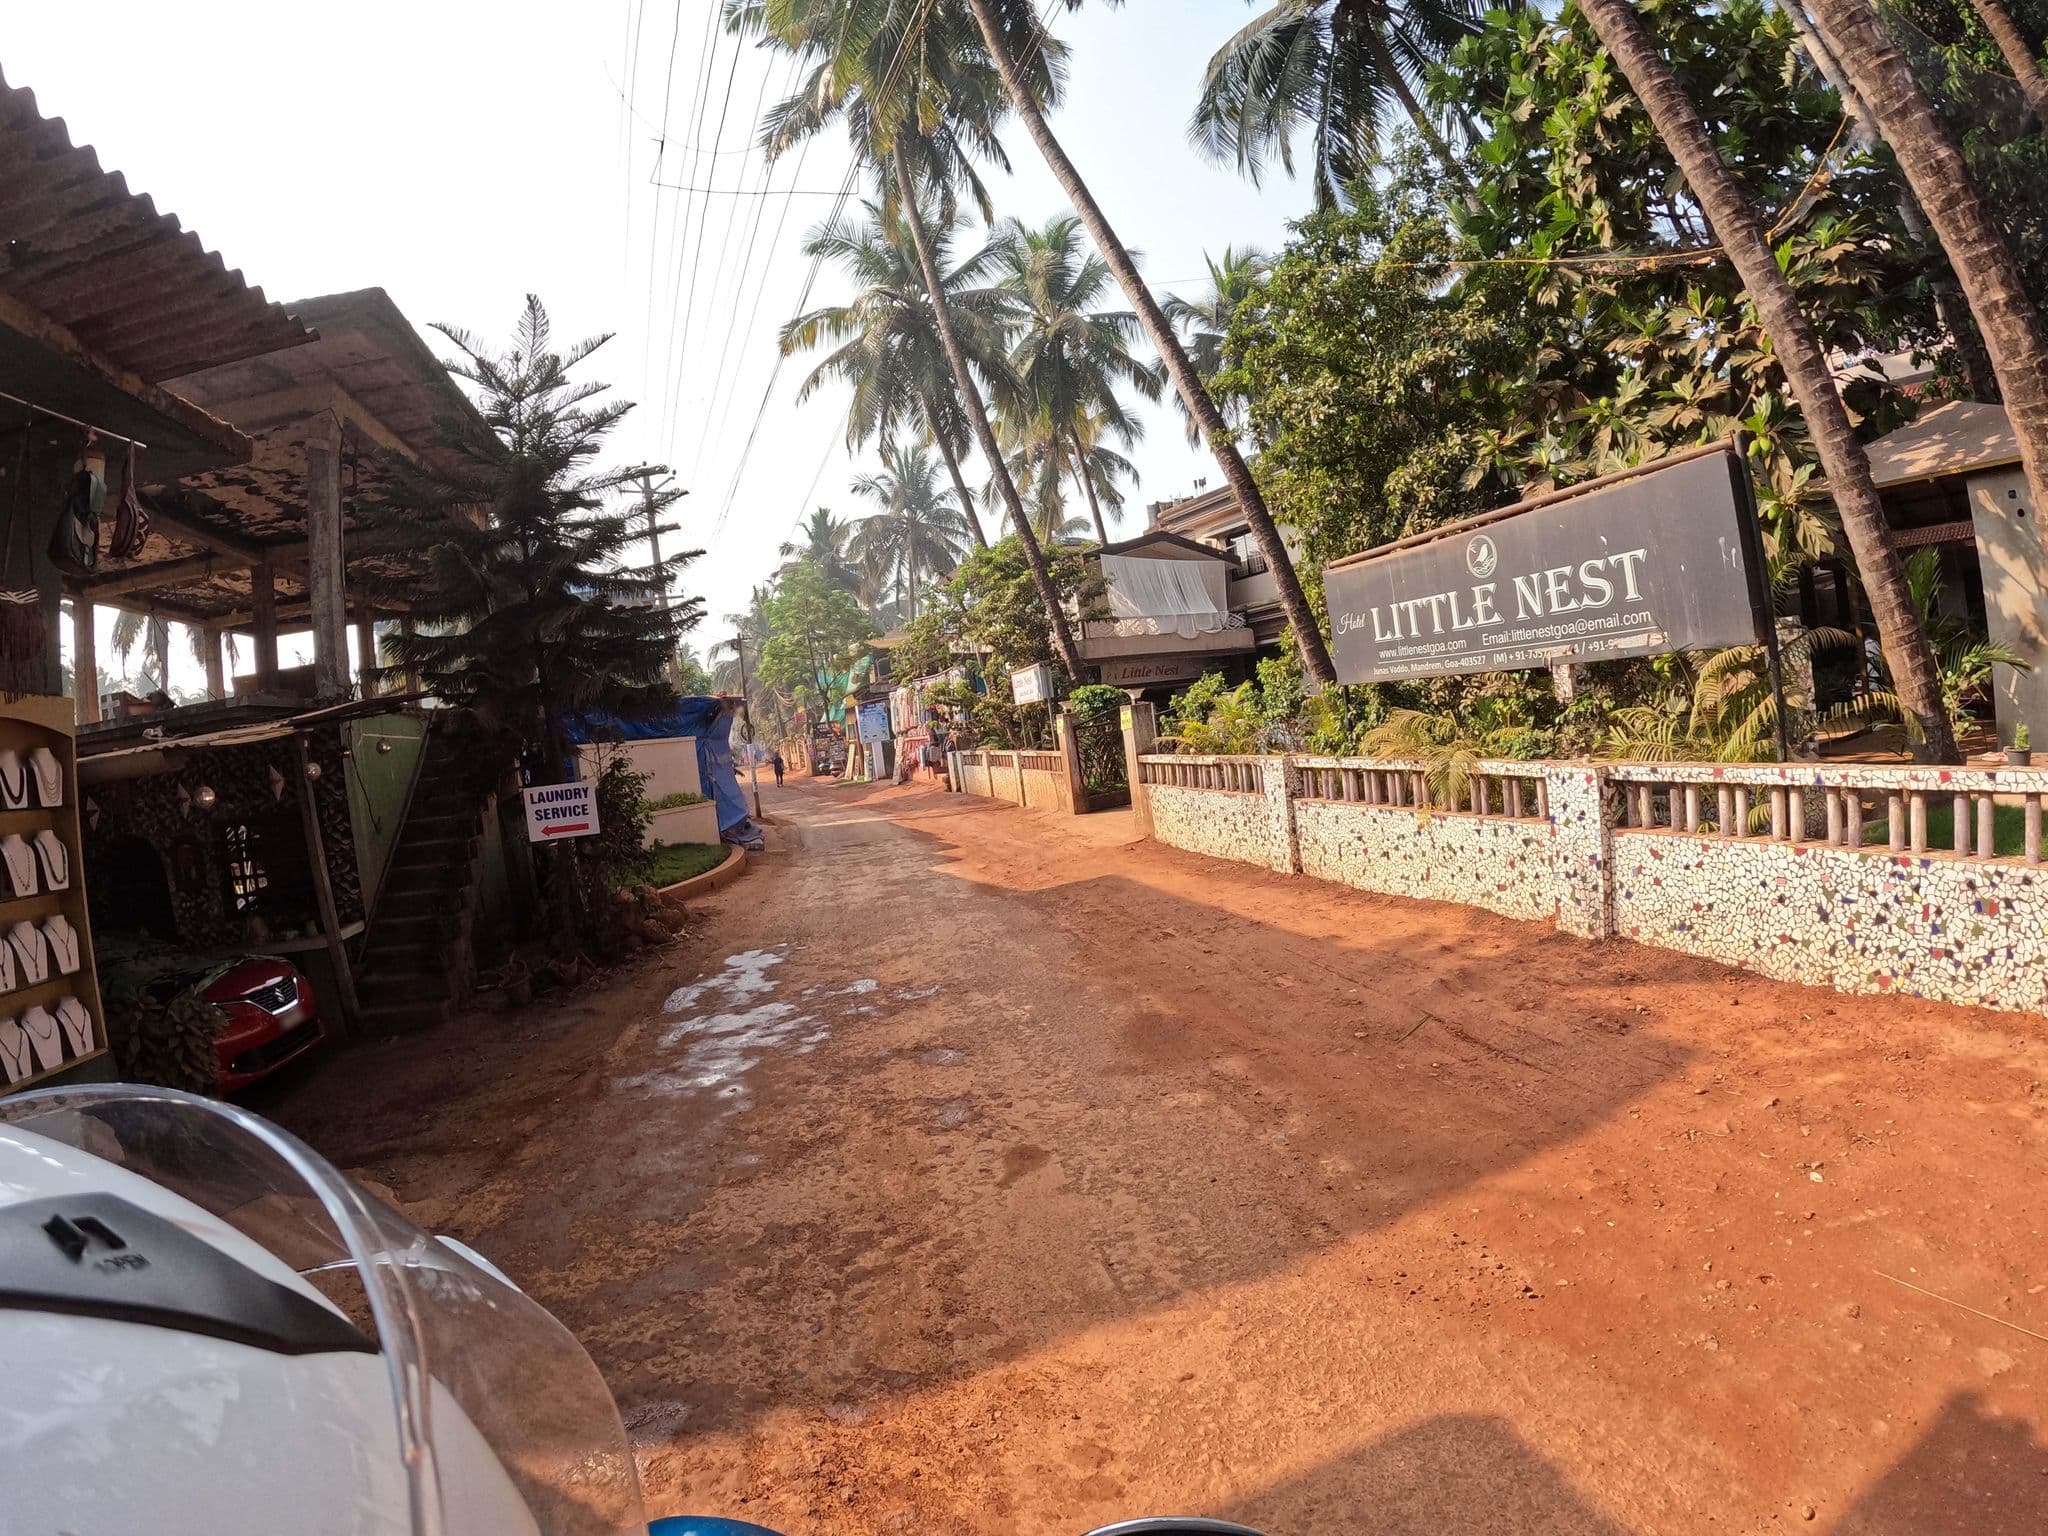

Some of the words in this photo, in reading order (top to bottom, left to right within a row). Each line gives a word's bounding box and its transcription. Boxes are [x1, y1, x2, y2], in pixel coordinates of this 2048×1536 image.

[1337, 613, 1366, 634] Hotel
[1370, 582, 1504, 642] LITTLE
[1512, 549, 1647, 621] NEST
[1379, 638, 1467, 659] www.littlenestgoa.com
[1445, 655, 1486, 668] Goa-403527
[1493, 652, 1508, 665] (M)
[1121, 666, 1152, 679] Little
[1155, 664, 1179, 676] Nest
[529, 787, 589, 804] LAUNDRY
[534, 804, 589, 821] SERVICE
